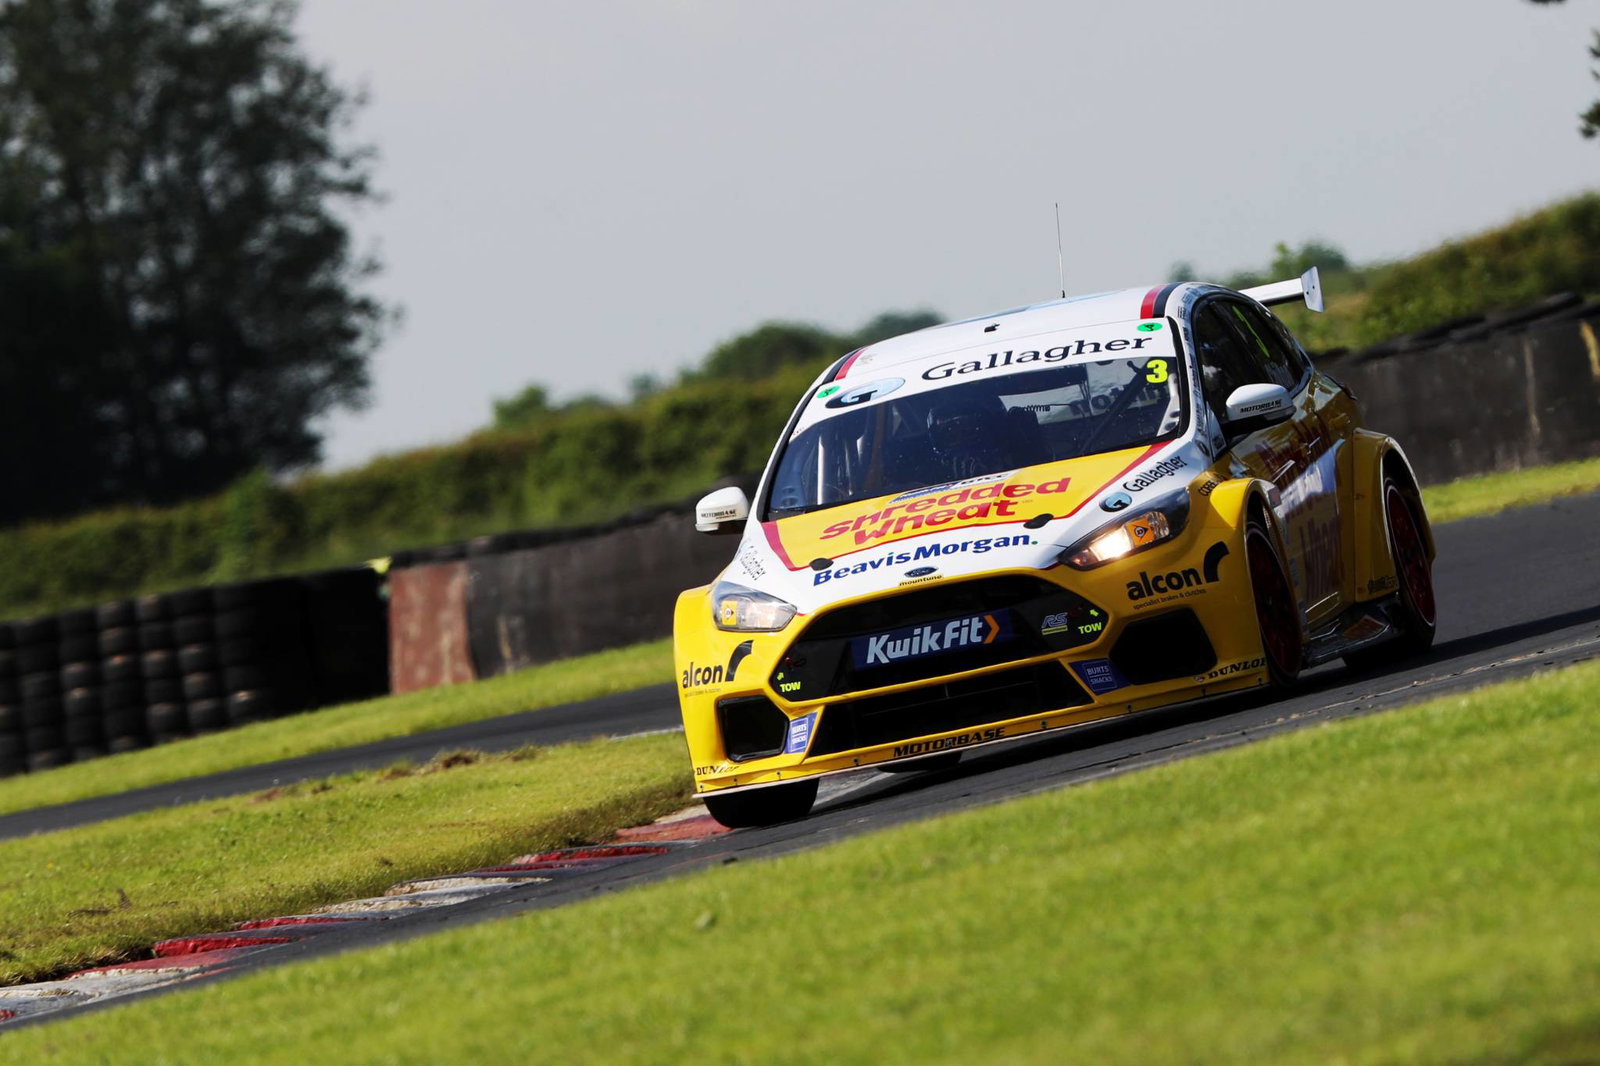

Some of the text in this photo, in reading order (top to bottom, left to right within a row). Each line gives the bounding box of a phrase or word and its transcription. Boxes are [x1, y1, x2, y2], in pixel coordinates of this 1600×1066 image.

[922, 337, 1152, 381] Gallagher
[1145, 359, 1168, 384] 3
[1122, 455, 1188, 492] Gallagher
[819, 477, 1072, 541] shredded
[853, 499, 1019, 546] wheat
[898, 574, 943, 587] mountune
[1126, 567, 1203, 601] alcon
[1078, 622, 1102, 635] TOW
[682, 661, 724, 689] alcon
[1086, 664, 1110, 676] BURTS
[779, 681, 801, 693] TOW
[893, 726, 1006, 758] MOTORBASE
